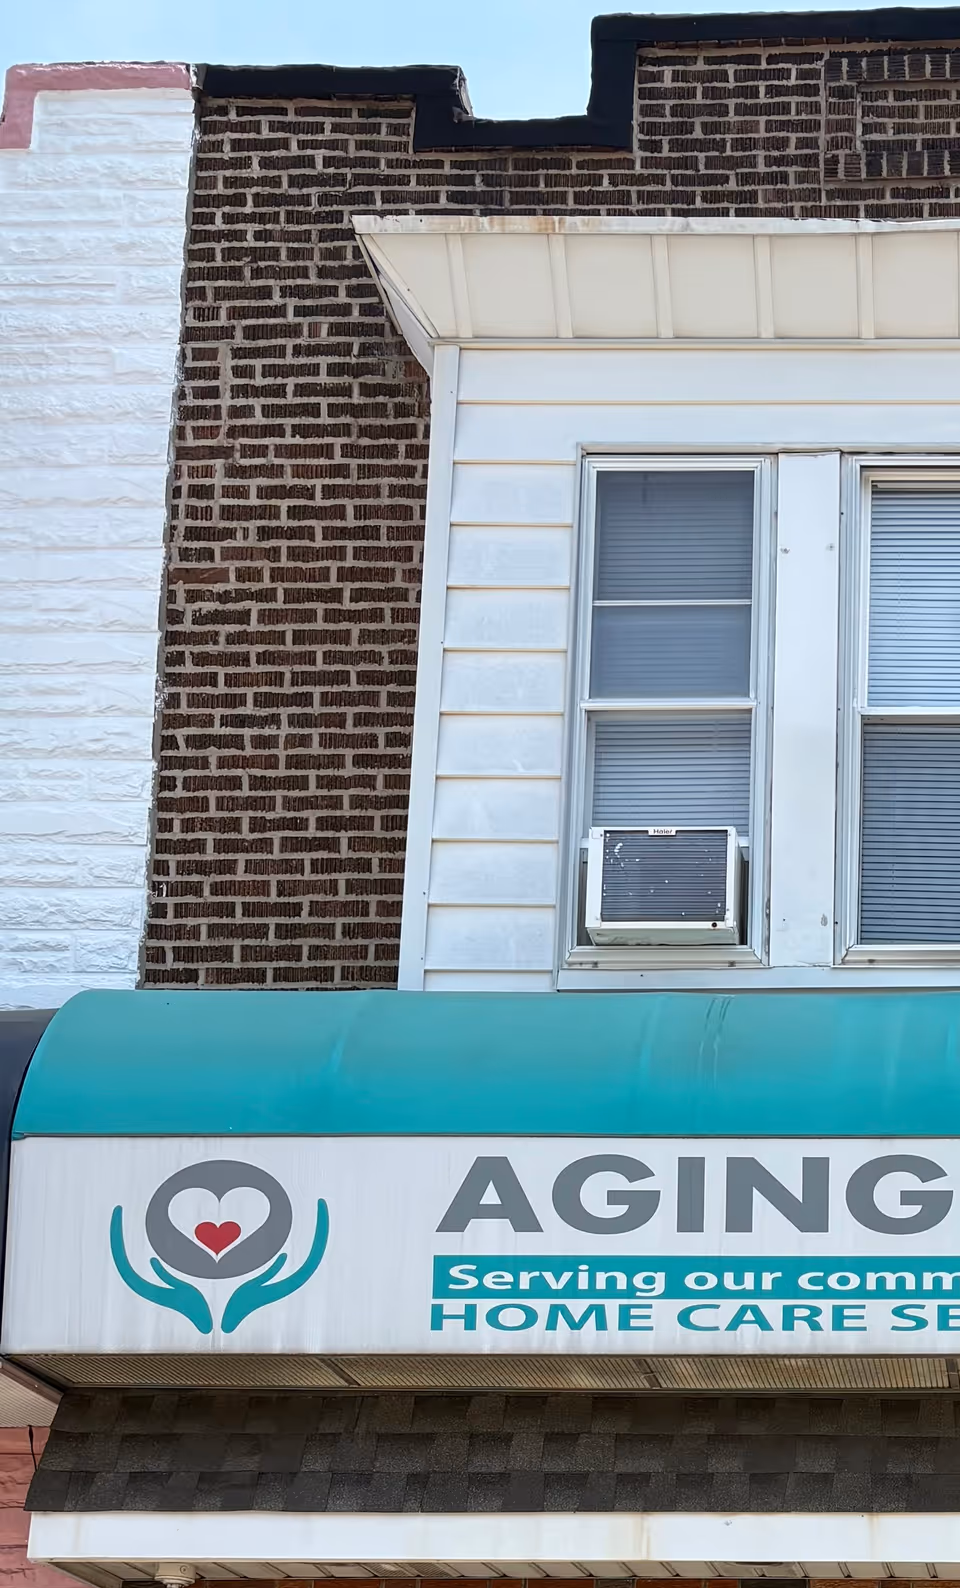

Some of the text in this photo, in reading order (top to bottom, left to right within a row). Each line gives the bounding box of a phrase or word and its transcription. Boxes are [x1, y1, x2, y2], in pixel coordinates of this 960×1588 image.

[435, 1153, 954, 1236] AGING
[448, 1264, 667, 1297] Serving
[684, 1270, 782, 1291] our
[430, 1302, 655, 1332] HOME
[676, 1302, 868, 1332] CARE
